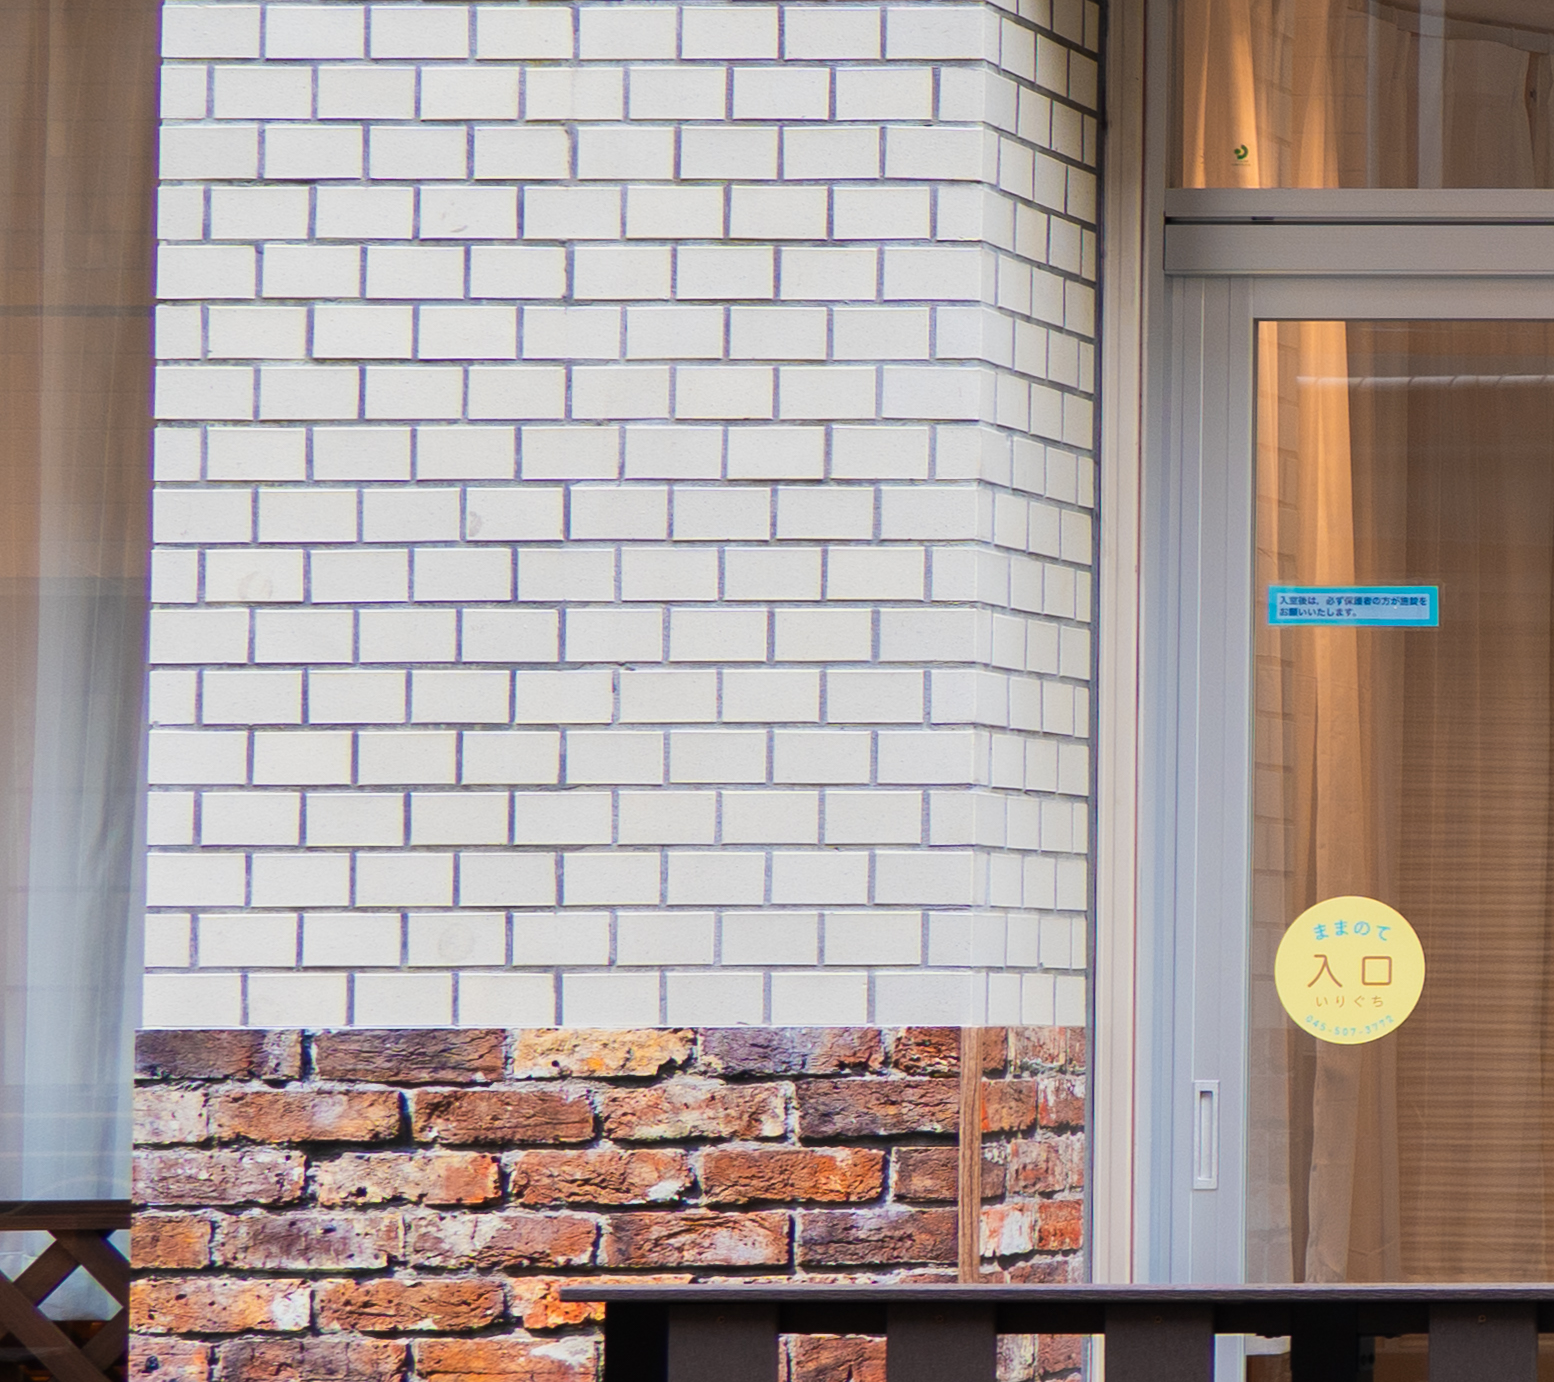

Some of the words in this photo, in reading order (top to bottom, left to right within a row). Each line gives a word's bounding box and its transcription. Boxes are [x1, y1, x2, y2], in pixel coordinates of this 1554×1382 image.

[1279, 607, 1357, 617] お願いいたします。
[1313, 919, 1392, 941] ままのて
[1307, 954, 1393, 988] 入口
[1315, 995, 1384, 1008] いりぐち
